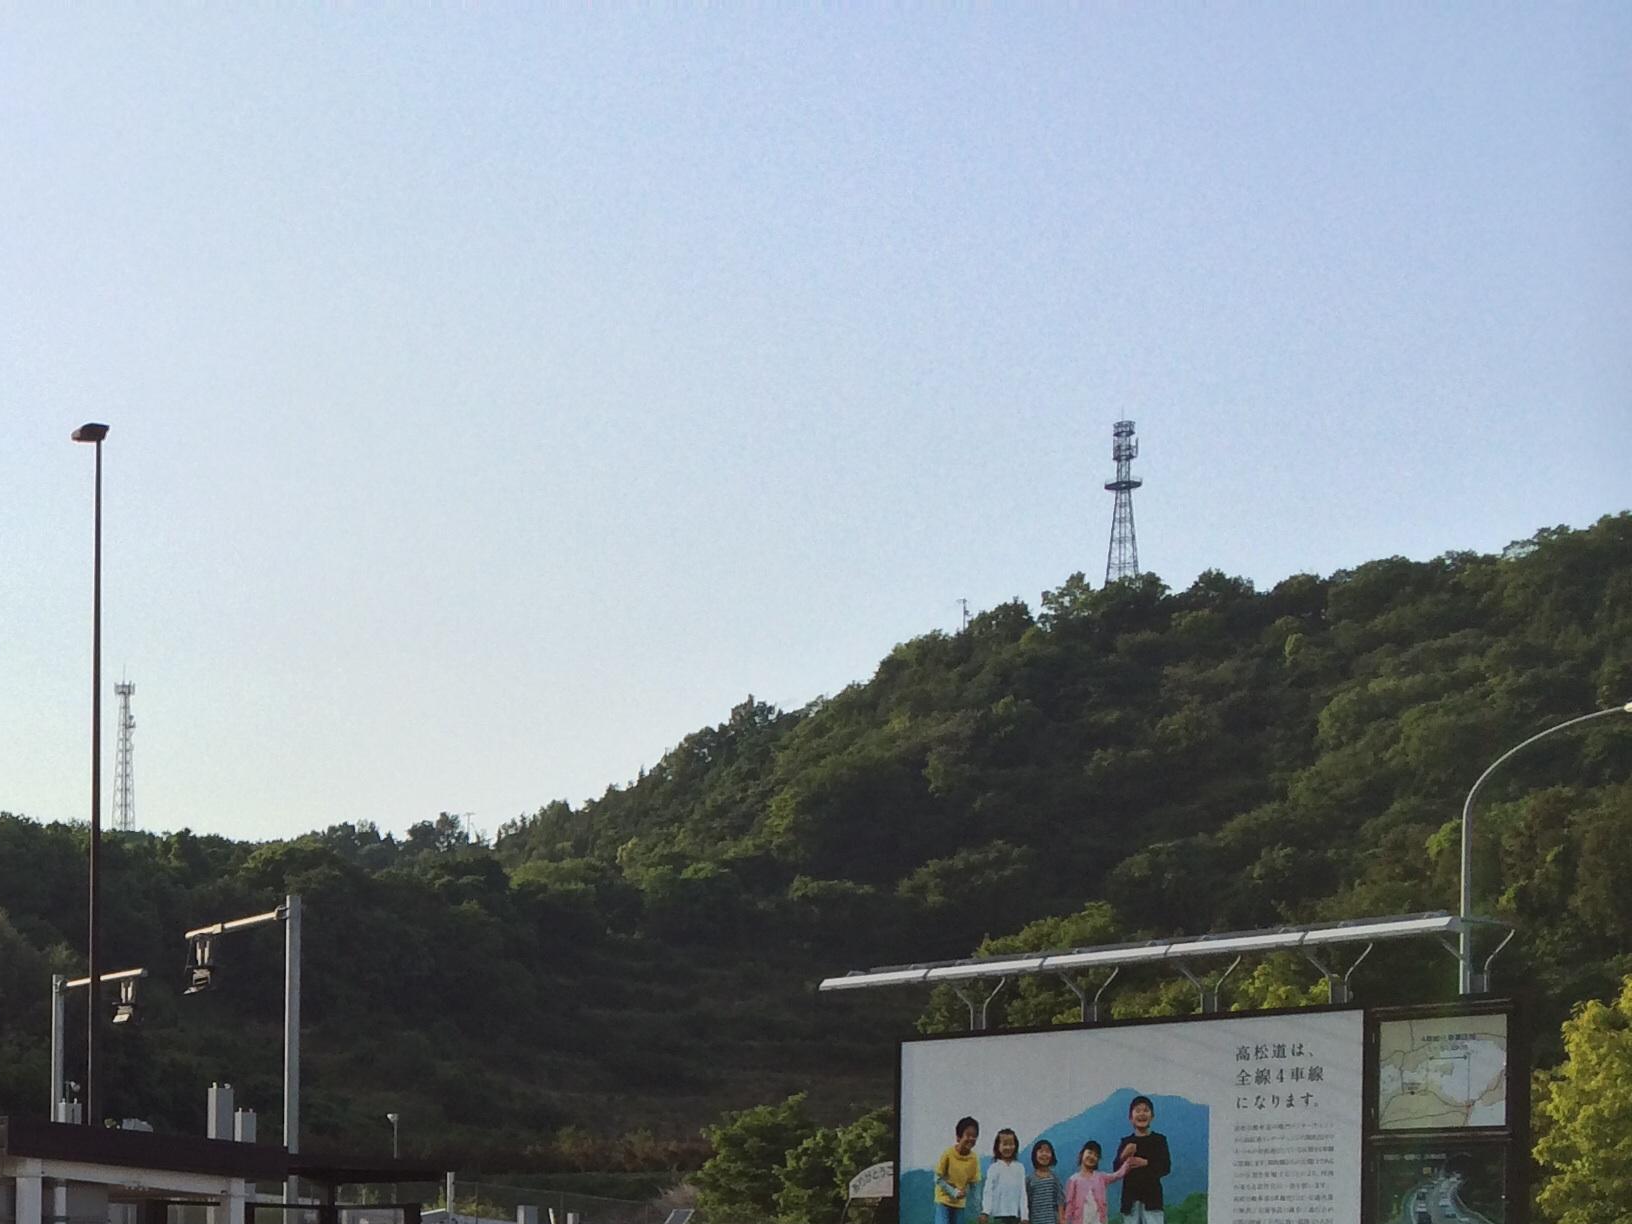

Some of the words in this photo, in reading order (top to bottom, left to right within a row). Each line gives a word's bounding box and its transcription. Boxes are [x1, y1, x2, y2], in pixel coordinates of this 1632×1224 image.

[1235, 1042, 1314, 1061] 高松道は、
[1235, 1065, 1324, 1086] 全線4車線
[1236, 1091, 1319, 1110] になります。
